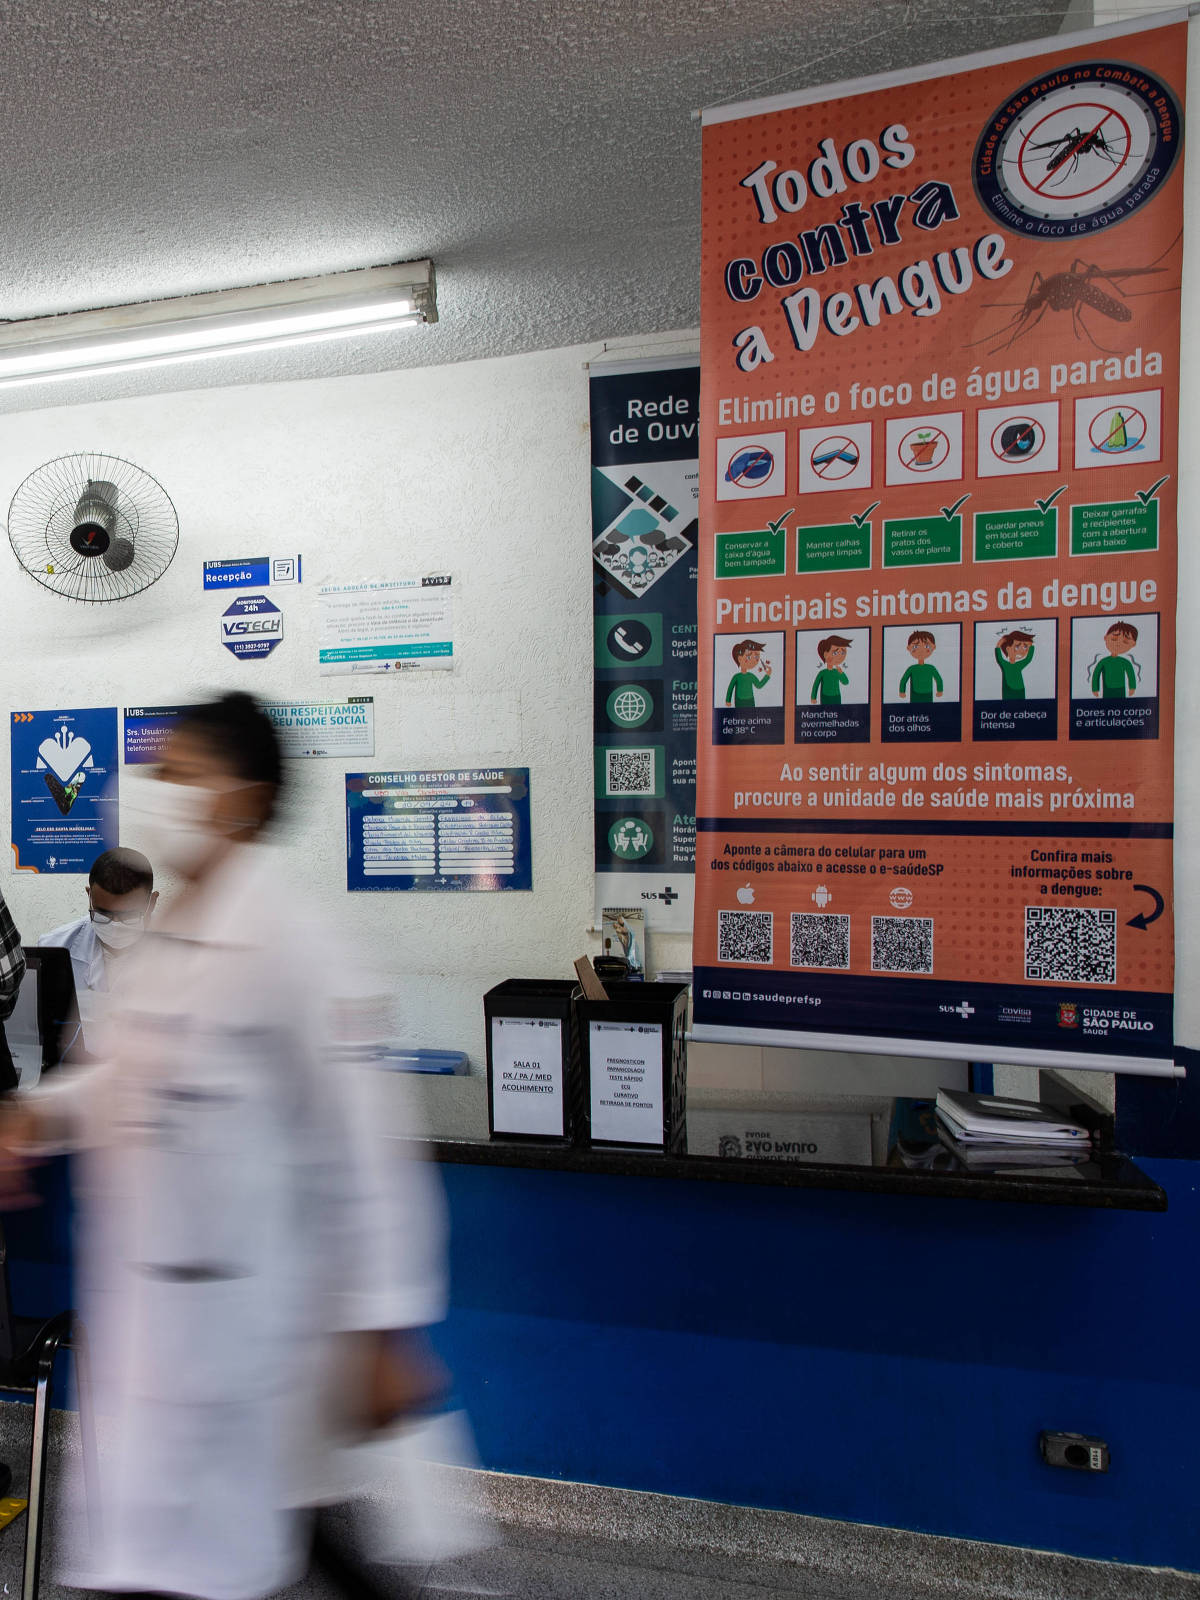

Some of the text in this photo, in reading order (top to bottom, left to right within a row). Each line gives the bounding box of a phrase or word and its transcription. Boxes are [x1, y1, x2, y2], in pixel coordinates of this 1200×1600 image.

[981, 134, 998, 175] Cidade
[995, 117, 1007, 130] de
[1031, 75, 1069, 96] Paulo
[1074, 70, 1090, 79] no
[1096, 68, 1151, 92] Combate
[1155, 97, 1172, 142] Dengue
[740, 124, 916, 224] Todos
[725, 180, 960, 302] contra
[733, 233, 1014, 372] a Dengue
[718, 348, 1163, 426] Elimine o foco de água parada
[628, 396, 689, 419] Rede
[610, 420, 699, 445] de Ouvi
[986, 520, 1044, 530] Guardar pneus
[1000, 531, 1018, 539] local
[806, 539, 860, 549] Manter calhas
[993, 540, 1023, 549] coberto
[806, 548, 862, 558] sempre limpas
[206, 571, 252, 582] Recepção
[717, 579, 1157, 626] Principais sintomas da dengue
[223, 620, 280, 635] VSTECH
[291, 705, 365, 716] RESPEITAMOS
[801, 711, 838, 719] Manchas
[999, 711, 1011, 719] de
[1014, 711, 1047, 720] cabeça
[1076, 709, 1105, 717] Dores
[1123, 708, 1152, 717] corpo
[273, 716, 368, 726] SEU NOME SOCIAL
[748, 717, 771, 725] acima
[801, 720, 859, 728] avermelhadas
[981, 721, 1015, 729] intensa
[1085, 718, 1144, 727] articulações
[889, 724, 931, 732] dos olhos
[814, 730, 836, 739] corpo
[369, 775, 416, 783] CONSELHO
[419, 773, 455, 782] GESTOR
[472, 770, 504, 780] SAÚDE
[780, 763, 1072, 785] Ao sentir algum dos sintomas,
[735, 787, 1134, 812] procure a unidade de saúde mais próxima
[724, 844, 926, 860] Aponte a câmera do celular para um
[1031, 850, 1112, 863] Confira mais
[711, 859, 944, 876] dos códigos abaixo e acesse o e-saúdeSP
[1011, 865, 1133, 880] informações sobre
[1040, 883, 1102, 897] a dengue:
[753, 992, 822, 1006] saudeprefsp
[1083, 1009, 1136, 1019] CIDADE DE
[1083, 1017, 1153, 1030] SÃO PAULO
[513, 1061, 529, 1069] SALA
[502, 1084, 553, 1093] ACOLHIMENTO
